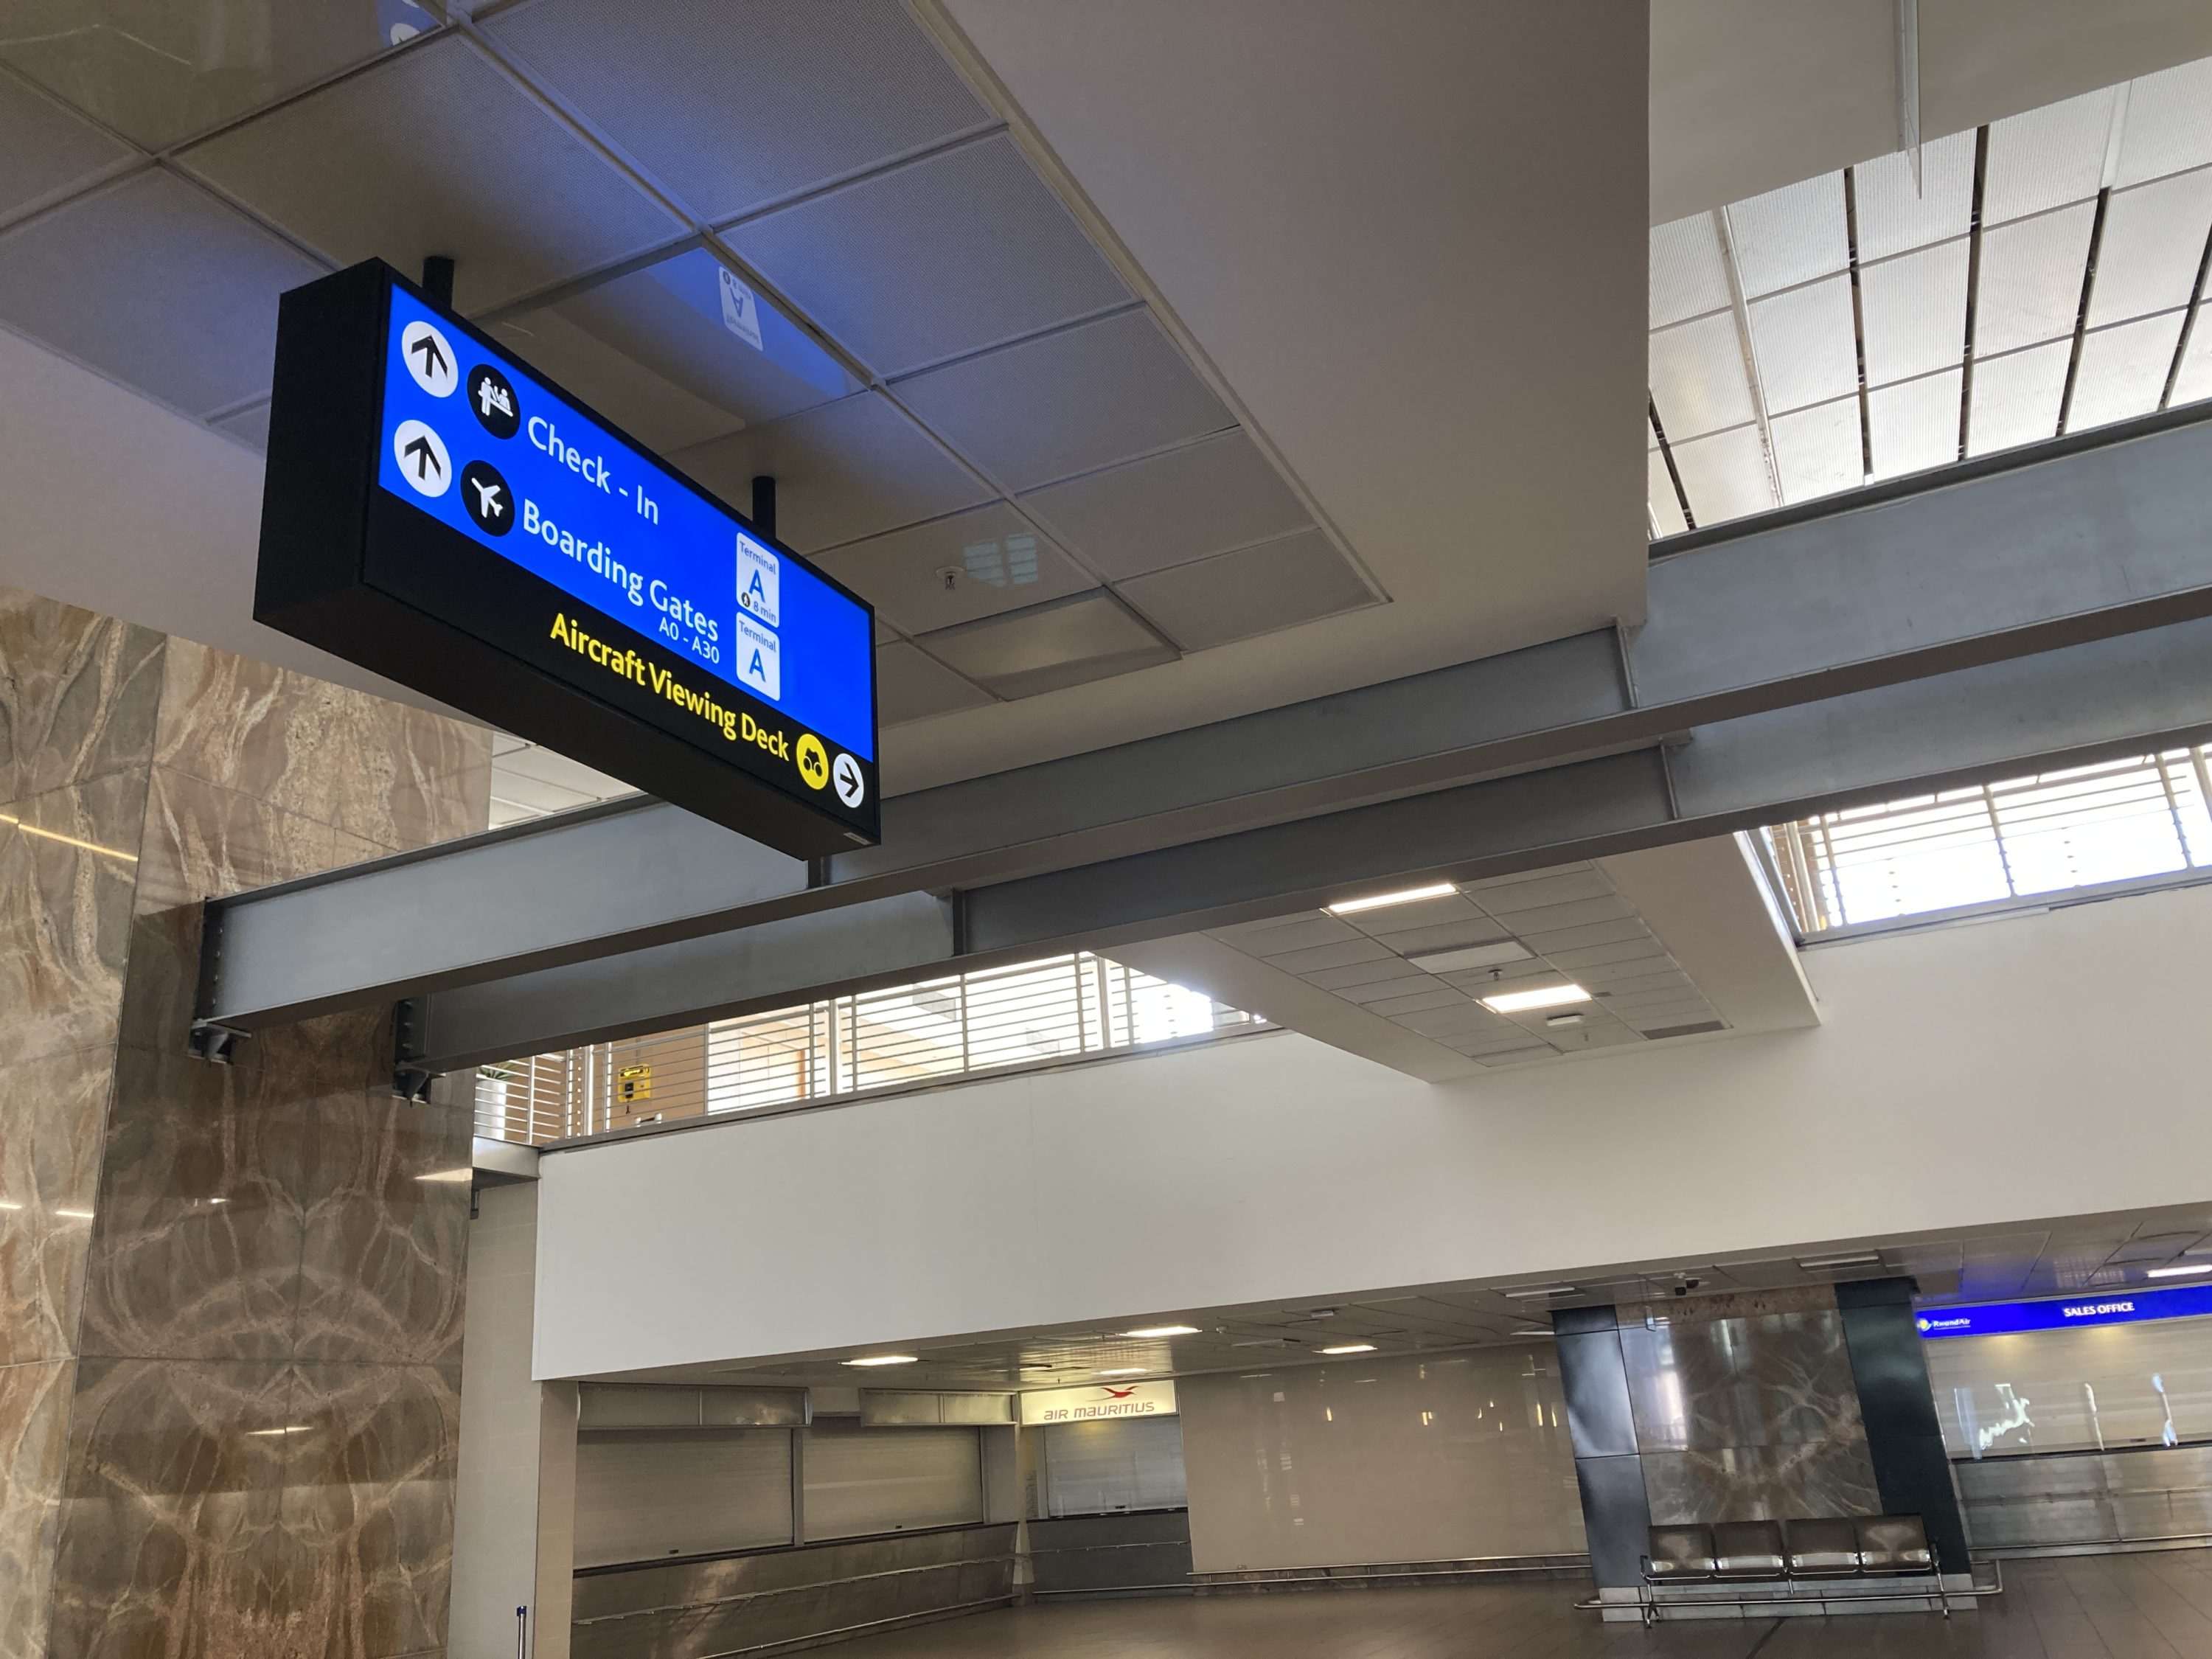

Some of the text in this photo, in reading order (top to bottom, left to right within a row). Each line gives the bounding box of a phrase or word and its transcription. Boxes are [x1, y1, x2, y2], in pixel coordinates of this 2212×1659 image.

[528, 416, 611, 494] Check
[637, 484, 658, 525] In
[523, 498, 718, 641] Boarding Gates
[740, 540, 776, 575] Terminal
[748, 568, 765, 603] A
[754, 600, 776, 623] 8 min
[658, 616, 678, 641] A0
[692, 636, 720, 664] A30
[740, 620, 776, 653] Terminal
[749, 647, 766, 683] A
[550, 613, 790, 762] Aircraft Viewing Deck
[1933, 1318, 1971, 1328] RwandAir
[2064, 1302, 2135, 1318] SALES OFFICE
